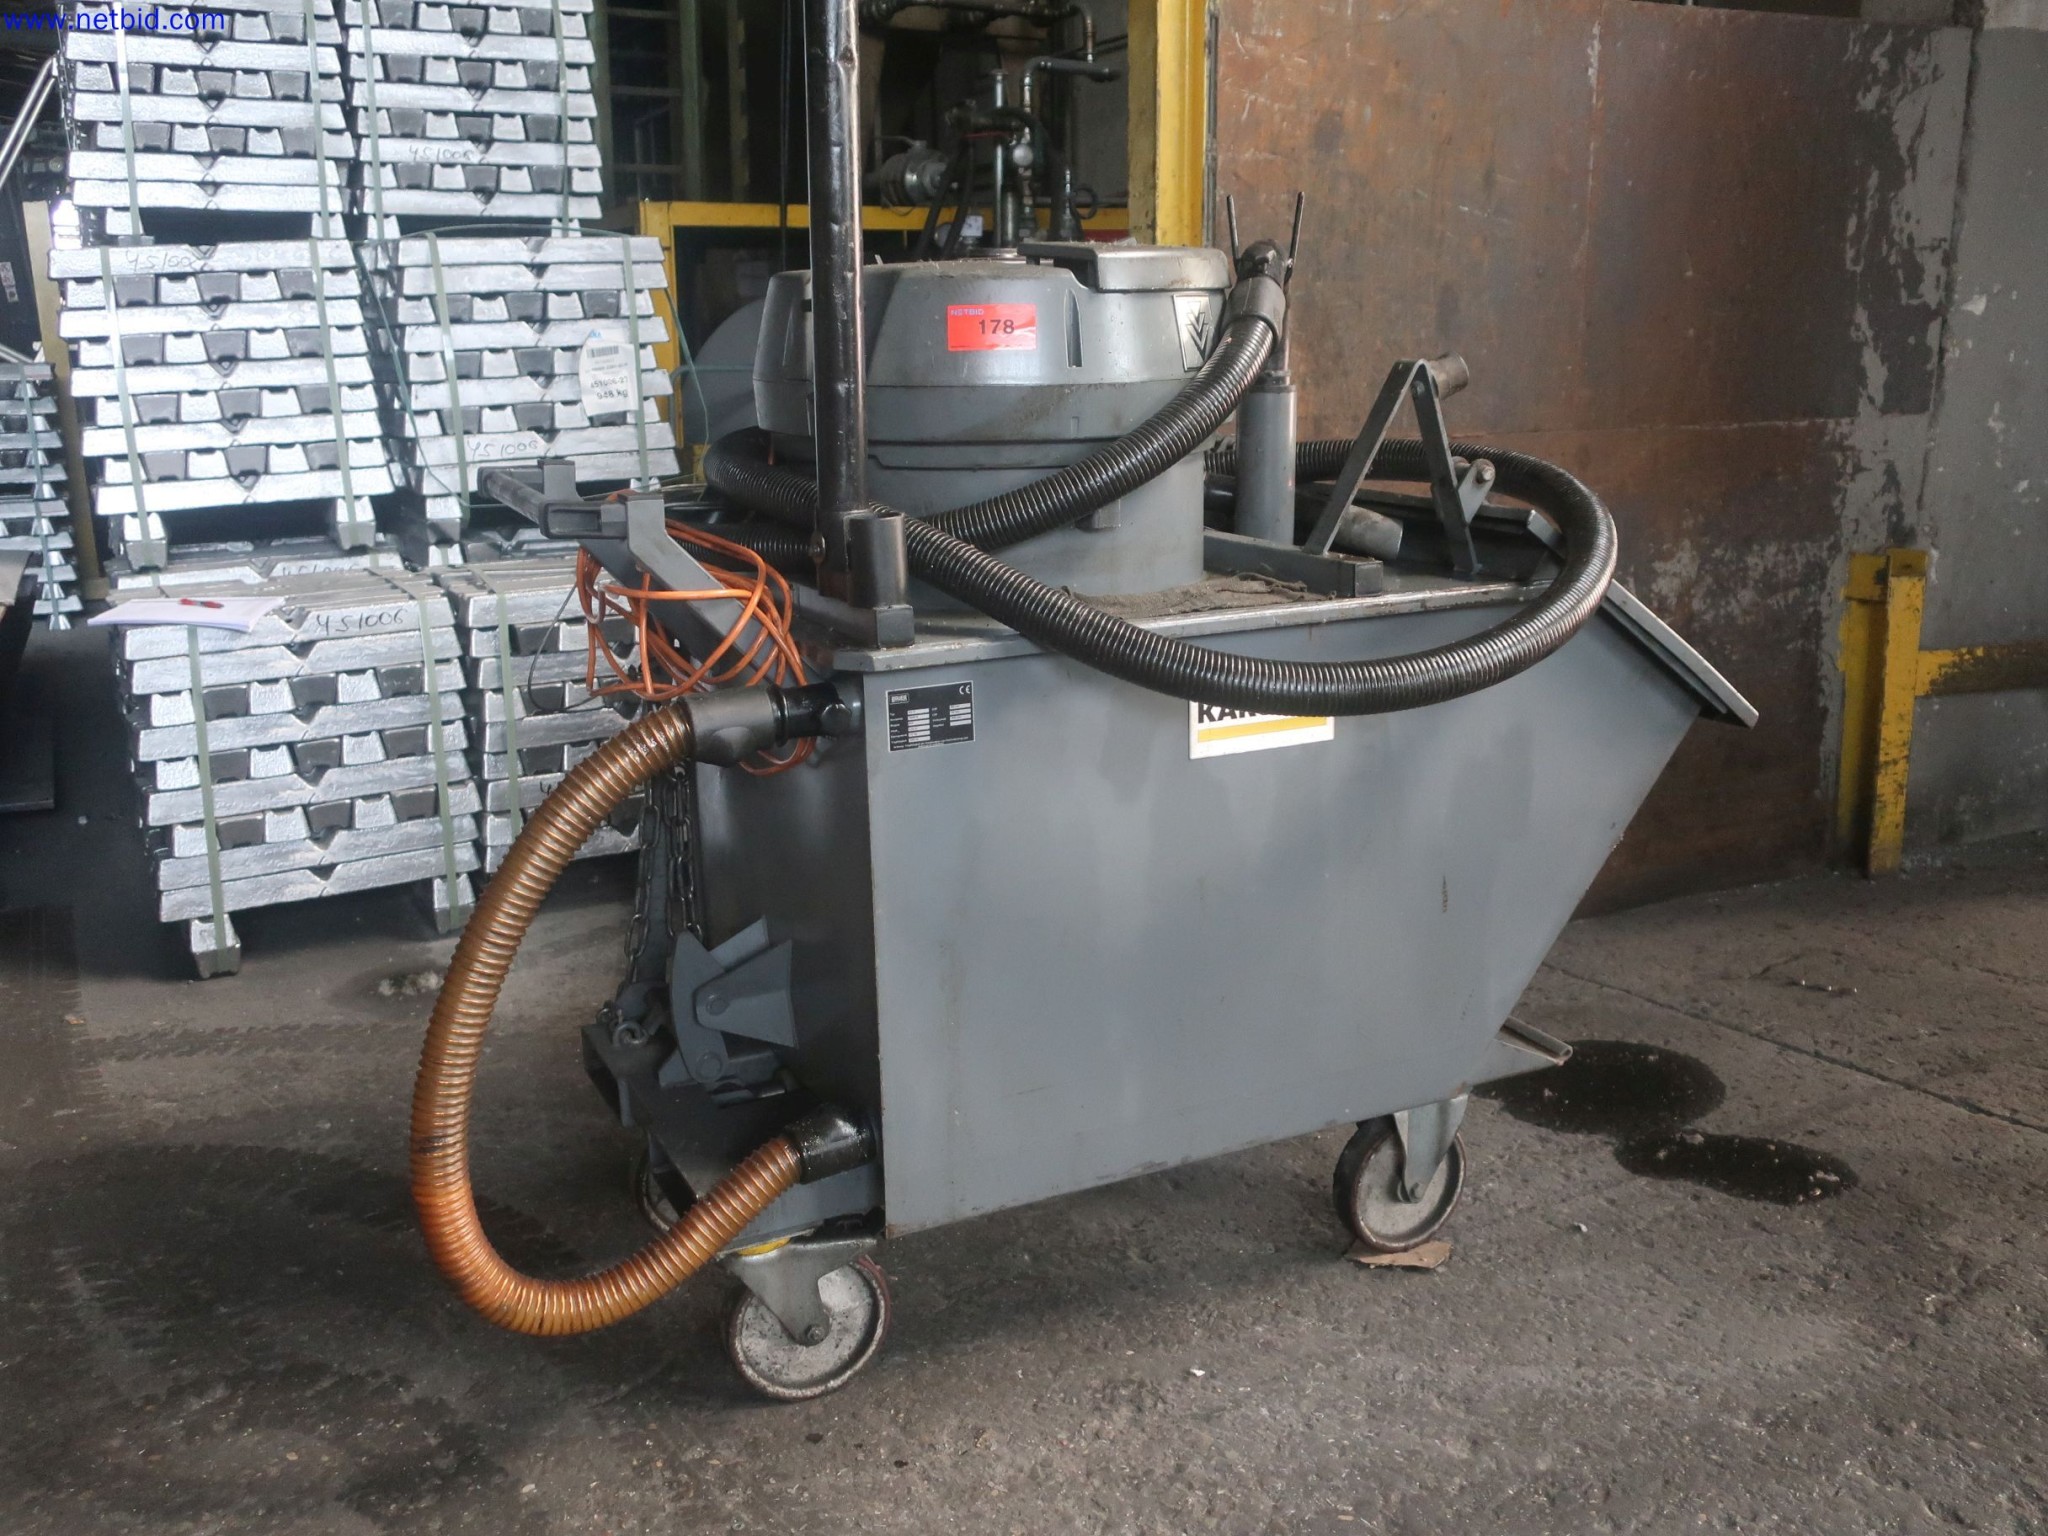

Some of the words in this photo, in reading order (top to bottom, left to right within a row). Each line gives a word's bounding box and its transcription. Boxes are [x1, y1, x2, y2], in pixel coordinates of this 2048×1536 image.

[950, 308, 984, 316] NETBID
[979, 319, 1015, 334] 178
[316, 608, 408, 635] 451006
